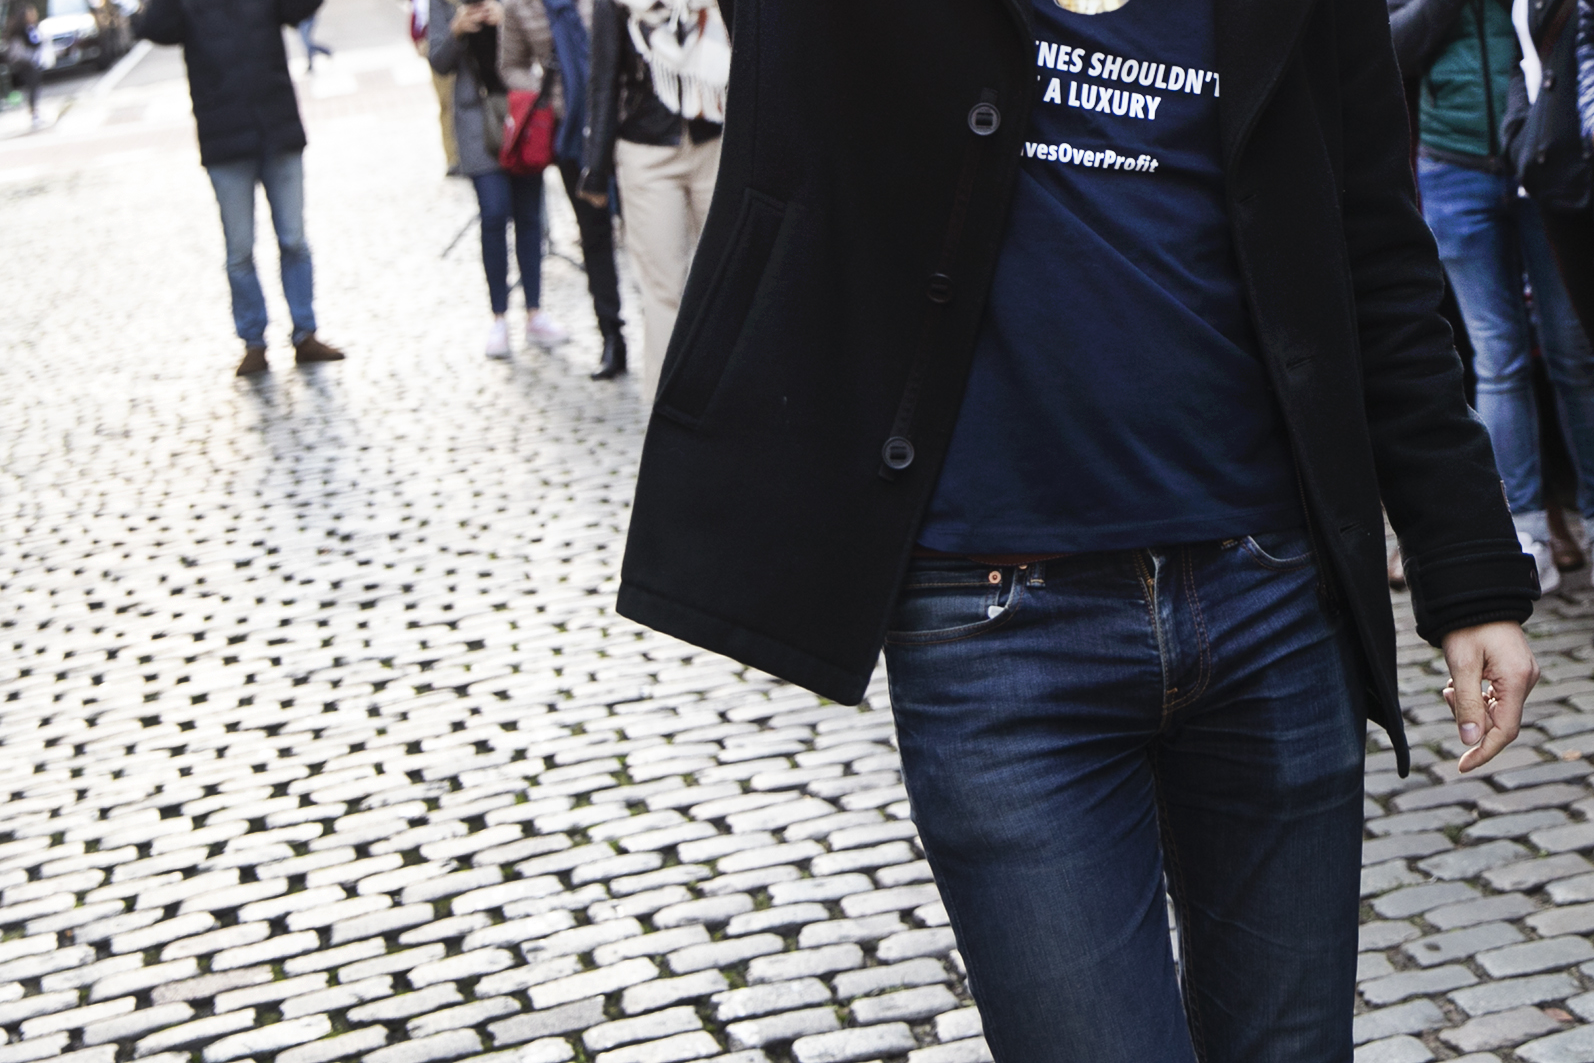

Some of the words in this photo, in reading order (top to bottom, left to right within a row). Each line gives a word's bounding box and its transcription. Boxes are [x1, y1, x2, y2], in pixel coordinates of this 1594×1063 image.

[1036, 40, 1085, 73] NES
[1043, 77, 1062, 104] A
[1067, 81, 1161, 120] LUXURY
[1021, 142, 1159, 172] vesOverProfit
